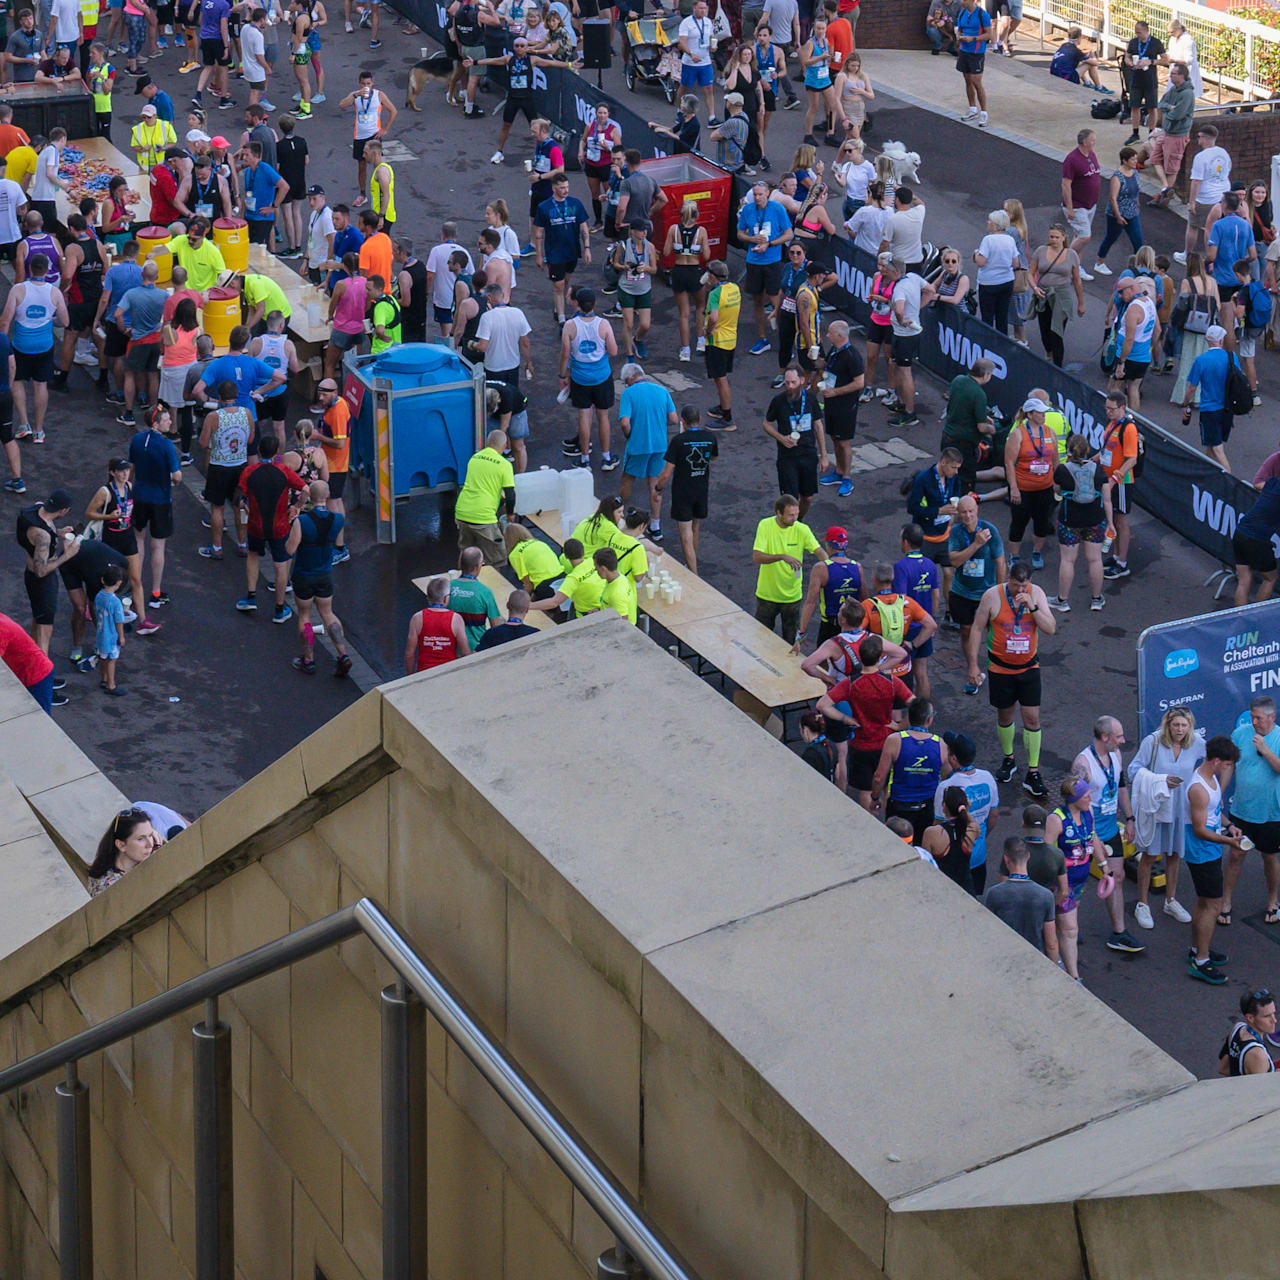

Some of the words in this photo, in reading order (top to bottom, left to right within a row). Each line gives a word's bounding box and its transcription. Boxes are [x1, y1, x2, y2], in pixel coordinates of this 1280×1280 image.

[1224, 631, 1260, 651] RUN
[1223, 663, 1231, 674] IN
[1230, 657, 1265, 672] ASSOCIATION
[1265, 654, 1279, 666] WITH
[1169, 693, 1205, 708] SAFRAN
